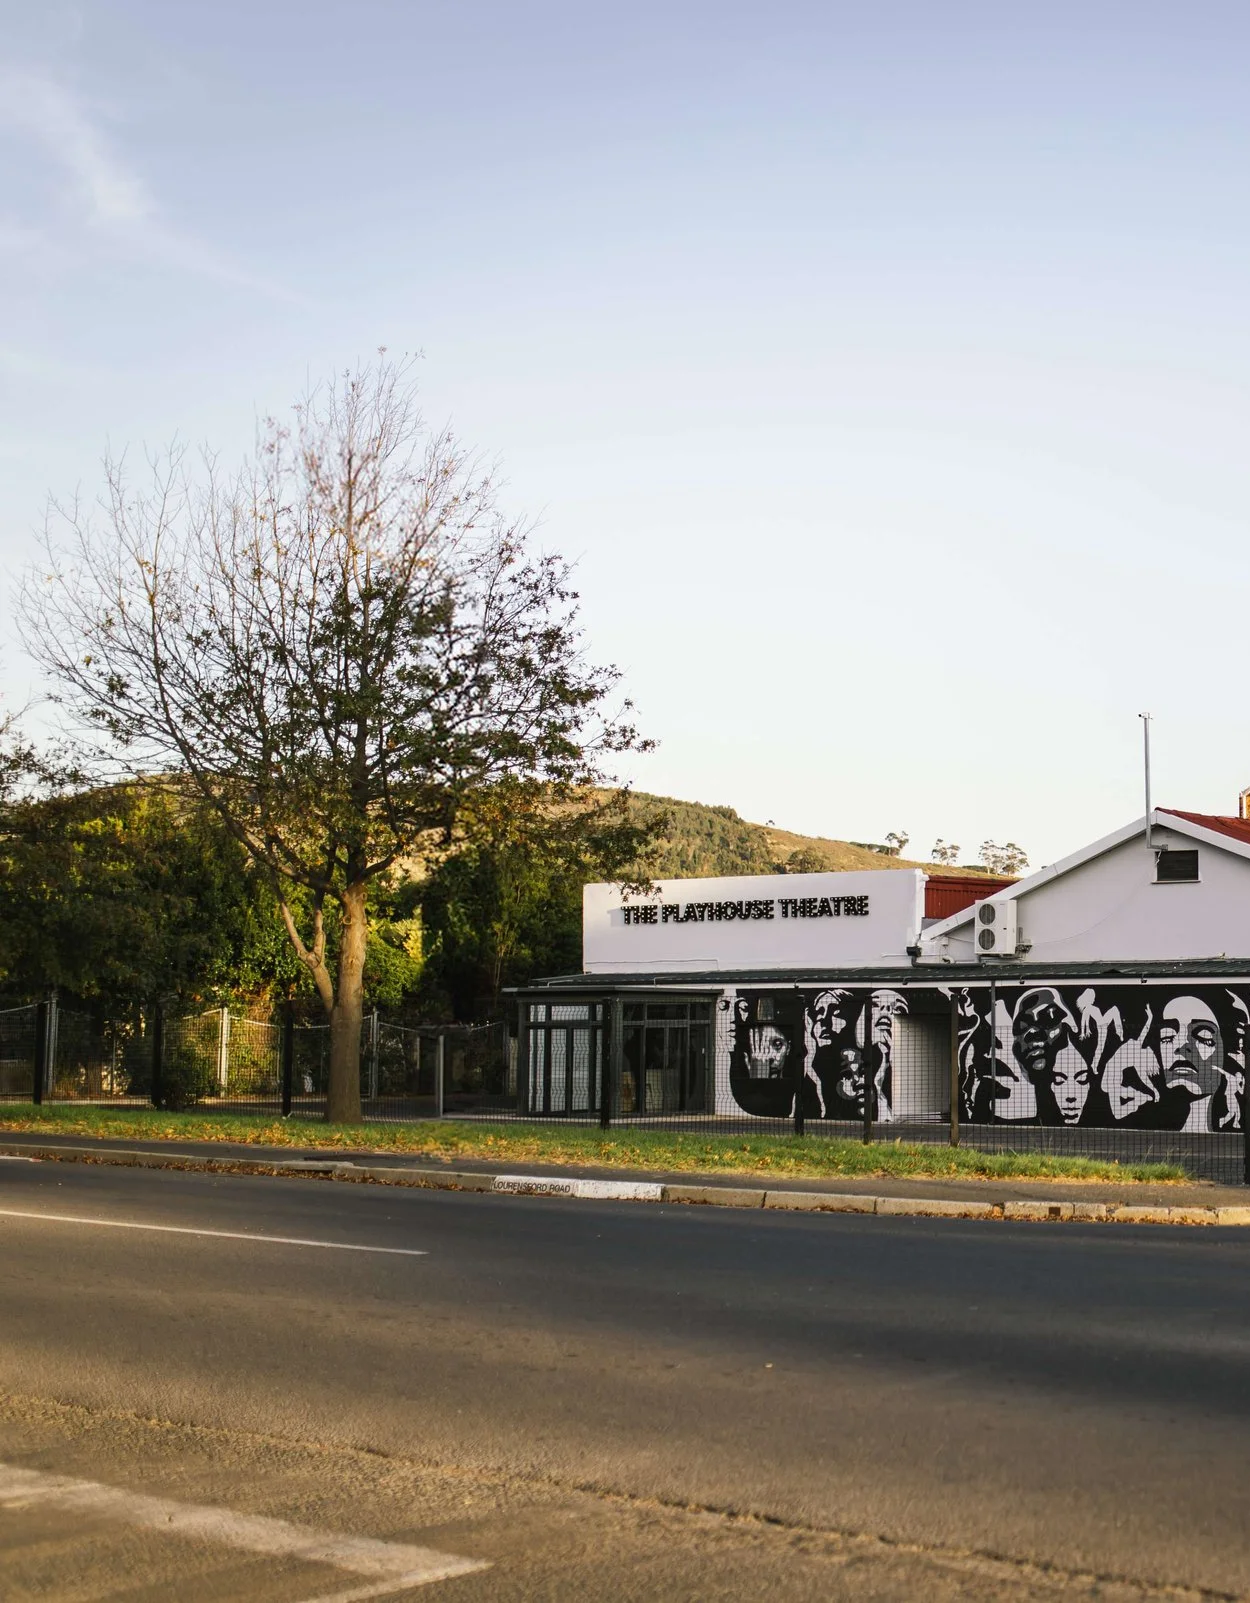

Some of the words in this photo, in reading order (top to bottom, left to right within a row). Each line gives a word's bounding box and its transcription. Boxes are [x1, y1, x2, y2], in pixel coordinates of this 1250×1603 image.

[621, 904, 658, 925] THE
[662, 899, 775, 923] PLAYHOUSE
[778, 895, 870, 918] THEATRE
[493, 1181, 547, 1192] LOURENSFORD
[549, 1184, 571, 1193] ROAD
